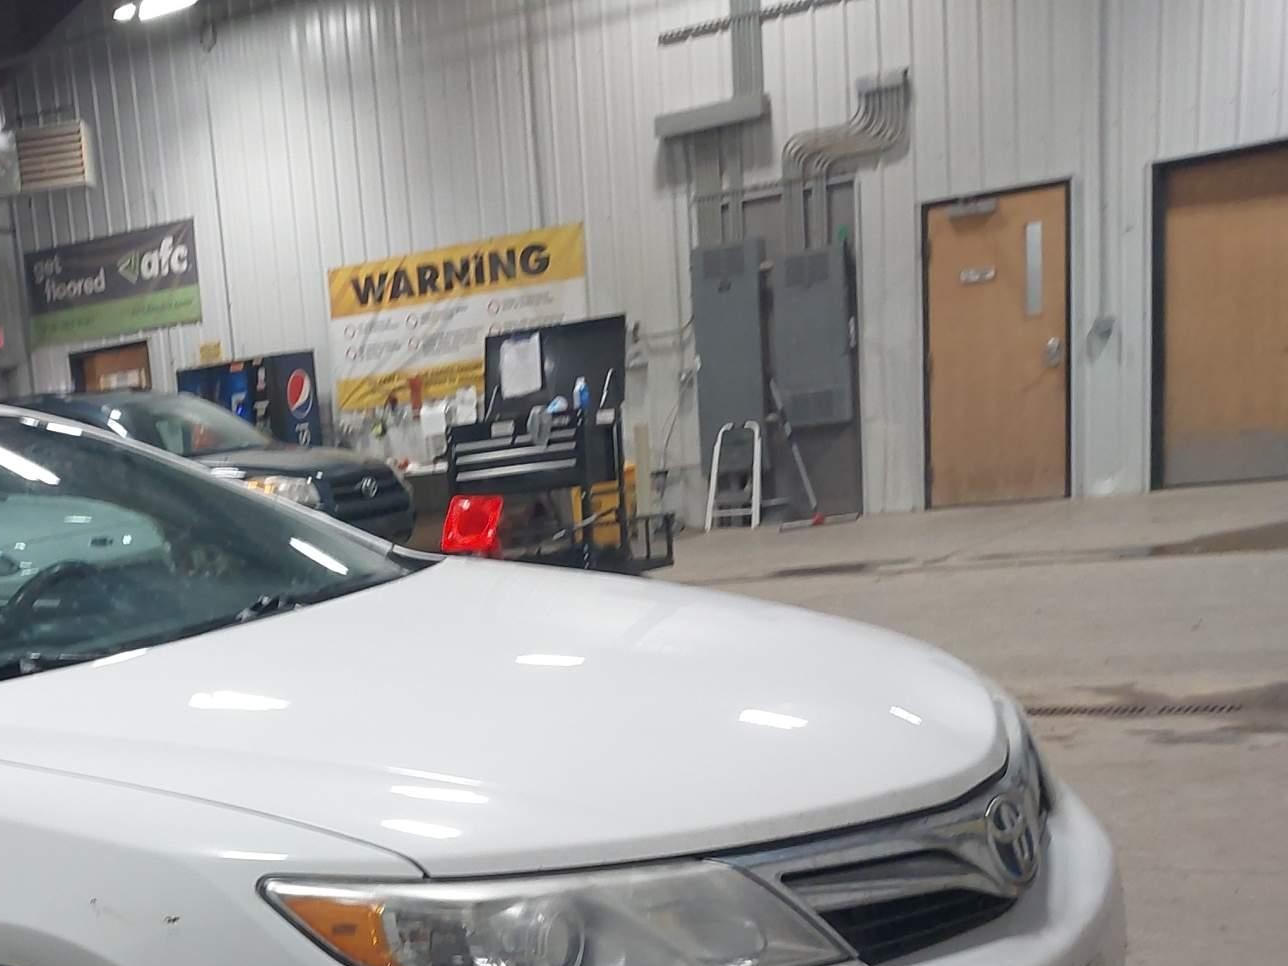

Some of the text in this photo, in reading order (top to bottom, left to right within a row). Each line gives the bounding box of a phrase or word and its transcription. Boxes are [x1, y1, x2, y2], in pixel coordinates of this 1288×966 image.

[33, 254, 62, 284] get
[140, 236, 189, 280] afc
[351, 244, 551, 307] WARNING
[44, 266, 107, 303] floored
